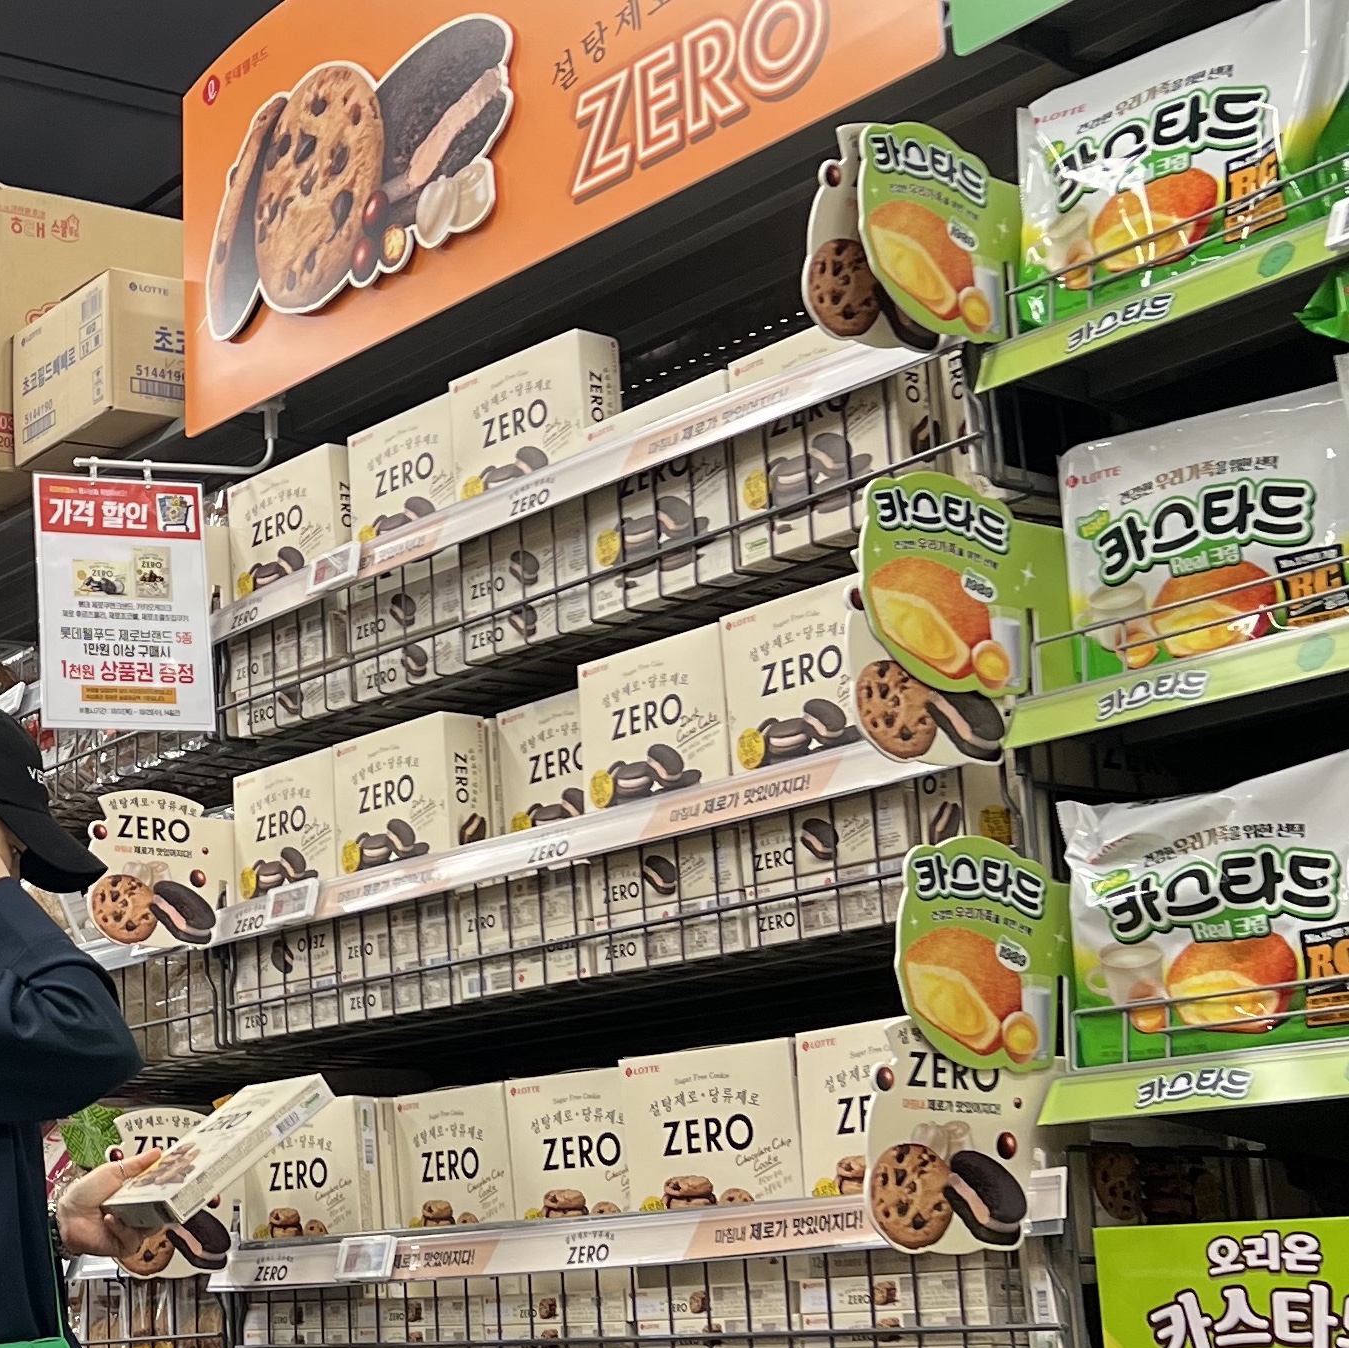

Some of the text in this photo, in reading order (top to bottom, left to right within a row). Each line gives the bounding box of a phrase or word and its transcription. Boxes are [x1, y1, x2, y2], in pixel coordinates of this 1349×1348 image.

[569, 0, 830, 205] ZERO
[1042, 104, 1087, 123] LOTTE
[869, 133, 986, 206] 카스타드
[138, 285, 169, 297] LOTTE
[1065, 294, 1175, 354] 카스타드
[588, 369, 604, 423] ZERO
[483, 398, 548, 448] ZERO
[375, 452, 434, 498] ZERO
[1082, 466, 1122, 484] LOTTE
[49, 499, 148, 530] 가격 할인
[338, 481, 352, 528] ZERO
[510, 488, 550, 517] ZERO
[252, 503, 303, 548] ZERO
[873, 486, 1008, 551] 카스타드
[1097, 481, 1309, 582] 카스타드
[1171, 553, 1209, 576] Real
[471, 576, 505, 600] ZERO
[1288, 564, 1342, 608] RC
[230, 606, 258, 630] ZERO
[356, 618, 386, 641] ZERO
[60, 627, 116, 641] 롯데웰푸드
[118, 629, 173, 643] 제로브랜드
[470, 627, 504, 650] ZERO
[83, 643, 171, 658] 1만원 이상 구매시
[61, 660, 194, 684] 1천원 상품권 증정
[366, 667, 397, 690] ZERO
[760, 644, 843, 697] ZERO
[1096, 669, 1209, 722] 카스타드
[247, 704, 275, 726] ZERO
[612, 693, 682, 741] ZERO
[453, 751, 469, 804] ZERO
[109, 796, 198, 818] 설탕제로·당류제로
[358, 774, 415, 814] ZERO
[669, 774, 810, 823] 마침내 제로가 맛있어지다!
[117, 814, 190, 843] ZERO
[255, 805, 307, 842] ZERO
[1243, 824, 1273, 838] 위한
[1276, 823, 1305, 838] 선택
[527, 840, 569, 864] ZERO
[913, 853, 1043, 916] 카스타드
[1105, 848, 1337, 938] 카스타드
[234, 914, 264, 934] ZERO
[758, 912, 796, 932] ZERO
[1194, 915, 1269, 940] Real 크림
[603, 942, 637, 961] ZERO
[809, 1037, 836, 1049] LOTTE
[633, 1065, 660, 1075] LOTTE
[674, 1071, 730, 1087] Sugar Free Cookie
[908, 1050, 1000, 1091] ZERO
[517, 1085, 541, 1096] LOTTE
[649, 1086, 760, 1117] 설탕제로·당류제로
[1135, 1067, 1254, 1106] 카스타드
[197, 1110, 253, 1134] ZERO
[530, 1105, 625, 1135] 설탕제로·당류제로
[663, 1113, 754, 1157] ZERO
[421, 1146, 479, 1183] ZERO
[542, 1131, 621, 1171] ZERO
[269, 1157, 327, 1192] ZERO
[714, 1210, 864, 1245] 마침내 제로가 맛있어지다!
[567, 1243, 609, 1265] ZERO
[1207, 1230, 1323, 1276] 오리온
[254, 1264, 288, 1281] ZERO
